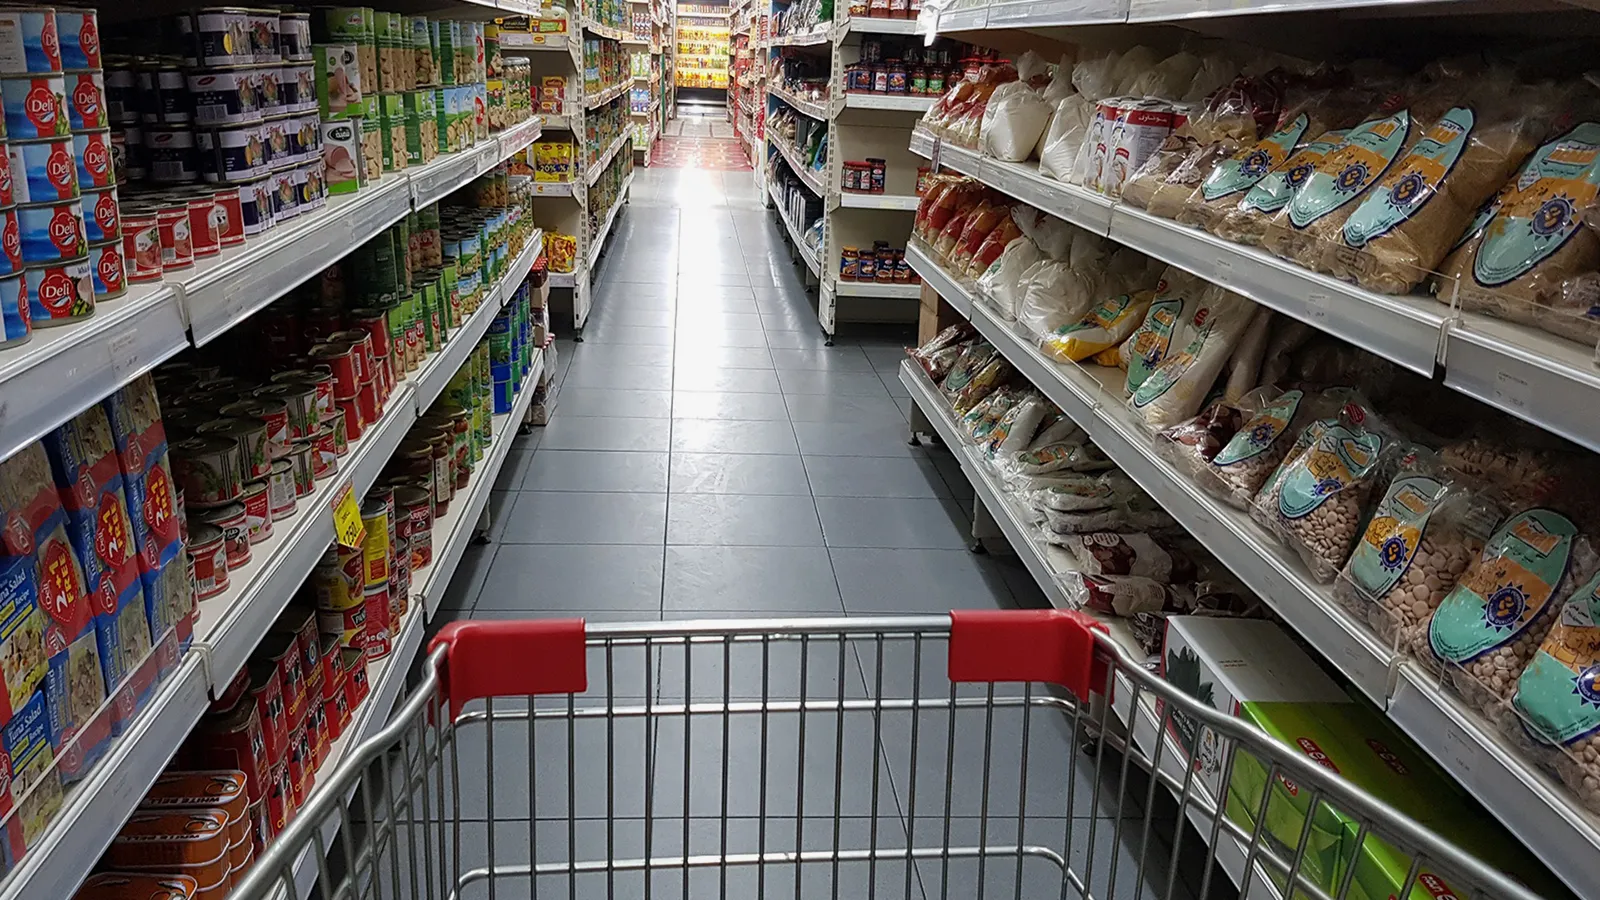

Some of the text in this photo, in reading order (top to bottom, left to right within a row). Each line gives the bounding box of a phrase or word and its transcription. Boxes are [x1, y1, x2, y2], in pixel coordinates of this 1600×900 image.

[32, 99, 54, 112] Deli
[79, 91, 97, 105] Deli
[89, 152, 106, 164] Deli
[53, 161, 70, 175] Deli
[55, 222, 75, 236] Deli
[103, 262, 119, 274] Deli
[46, 283, 70, 298] Deli
[80, 474, 94, 506] Deli
[110, 502, 124, 549] FREE
[97, 530, 105, 554] Deli
[58, 553, 75, 604] FREE
[101, 581, 114, 609] Deli
[8, 702, 42, 743] Tuna Salad
